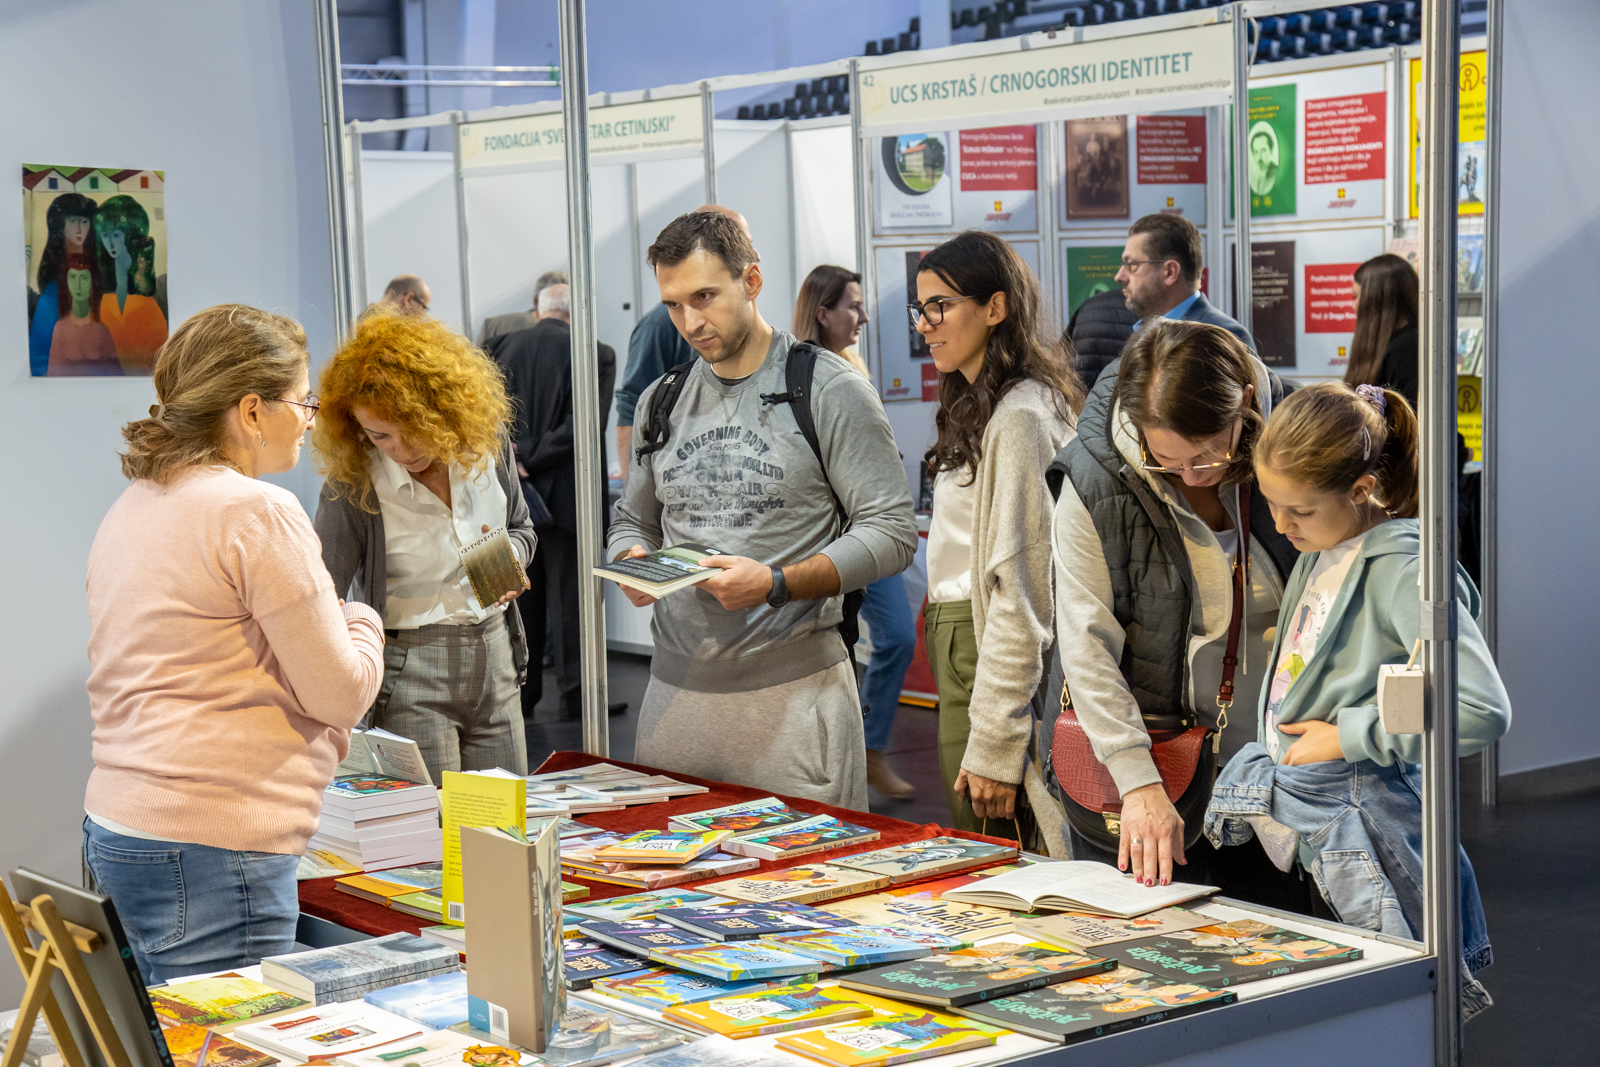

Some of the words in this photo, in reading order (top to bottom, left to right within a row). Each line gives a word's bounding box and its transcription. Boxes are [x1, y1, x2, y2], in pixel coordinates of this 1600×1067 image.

[863, 75, 875, 87] 42
[890, 84, 918, 104] UCS
[922, 74, 977, 101] KRSTAŠ
[981, 76, 986, 95] /
[990, 63, 1096, 94] CRNOGORSKI
[1102, 52, 1192, 82] IDENTITET
[484, 131, 540, 151] FONDACIJA
[1346, 141, 1383, 152] DOKUMENTI
[677, 426, 741, 460] GOVERNING
[742, 430, 769, 456] BODY
[734, 497, 785, 514] thoughts
